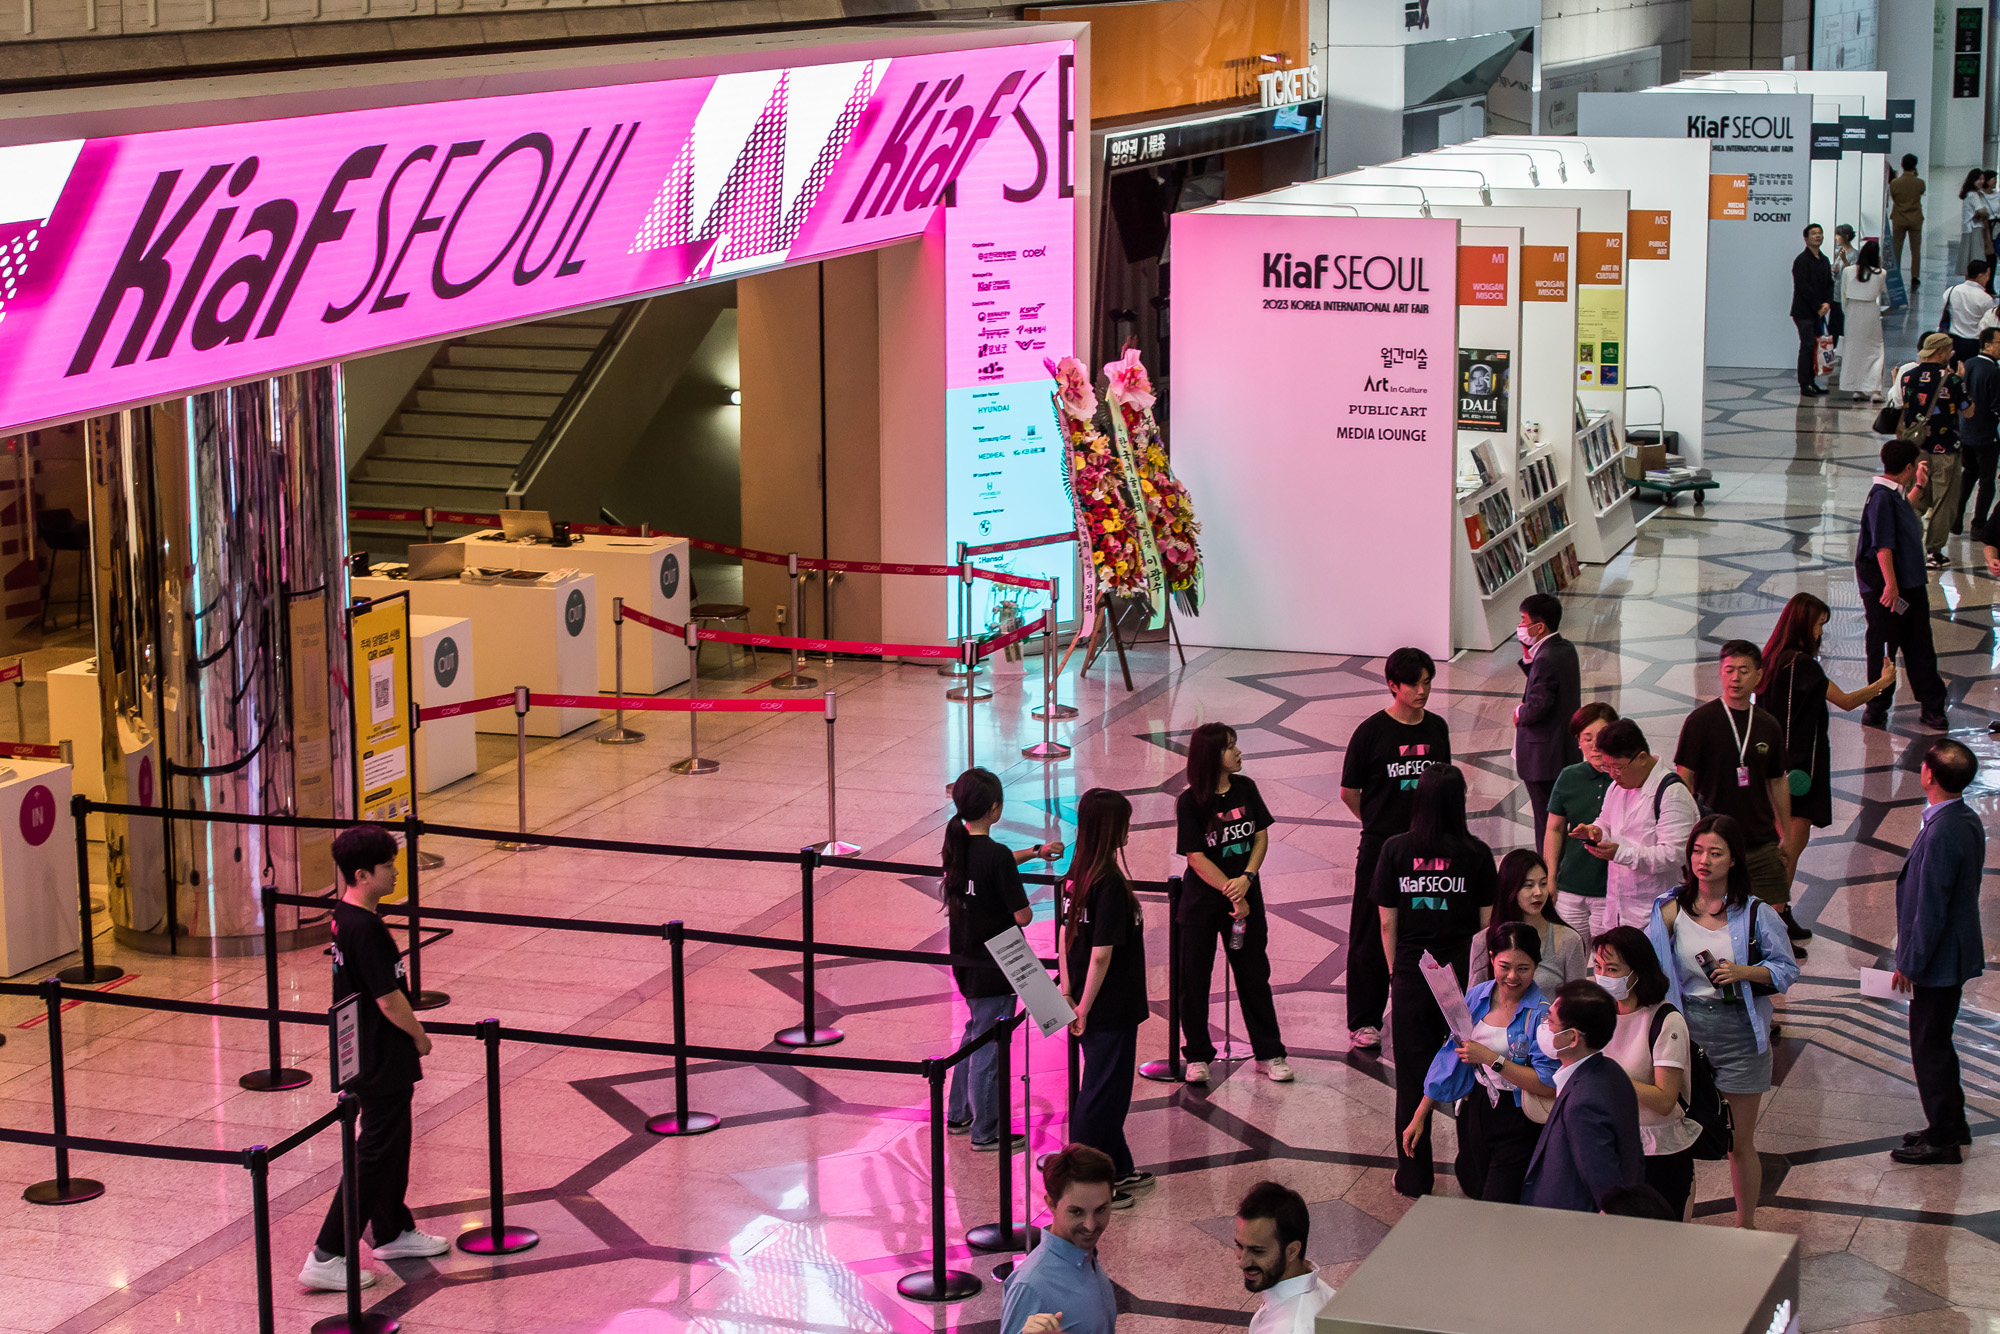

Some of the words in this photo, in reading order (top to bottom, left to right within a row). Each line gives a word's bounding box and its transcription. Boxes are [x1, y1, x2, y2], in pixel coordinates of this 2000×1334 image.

[1257, 65, 1319, 107] TICKETS
[1687, 116, 1730, 139] Kiaf
[1733, 116, 1794, 139] SEOUL
[842, 69, 1026, 224] Kiaf
[1112, 138, 1139, 167] 입장권
[1733, 180, 1746, 188] M4
[1655, 216, 1669, 225] M3
[1754, 213, 1792, 222] DOCENT
[65, 144, 388, 378] Kiaf
[321, 121, 641, 324] SEOUL
[1606, 238, 1620, 248] M2
[1022, 246, 1047, 258] coex
[1492, 253, 1505, 264] M1
[1553, 253, 1566, 263] M1
[1263, 253, 1329, 289] Kiaf
[1333, 255, 1430, 292] SEOUL
[1595, 272, 1620, 280] CULTURE
[1473, 283, 1505, 291] WOLGAN
[1535, 280, 1565, 288] WOLGAN
[1476, 292, 1504, 300] MISOOL
[1263, 299, 1289, 310] 2023
[1291, 300, 1322, 311] KOREA
[1324, 301, 1391, 313] INTERNATIONAL
[1393, 303, 1409, 314] ART
[1411, 304, 1430, 315] FAIR
[1380, 347, 1429, 370] 월간미술
[1364, 375, 1390, 393] Art
[978, 404, 1010, 414] HYUNDAI
[1349, 405, 1399, 416] PUBLIC
[1400, 407, 1428, 417] ART
[1460, 397, 1499, 412] DALÍ
[1337, 427, 1376, 441] MEDIA
[1378, 428, 1427, 442] LOUNGE
[829, 562, 848, 570] coex
[982, 554, 1004, 564] Hansol
[663, 567, 679, 586] OUT
[1147, 556, 1164, 595] 이광수
[568, 605, 583, 624] OUT
[698, 631, 717, 640] coex
[752, 637, 771, 645] coex
[809, 642, 828, 650] coex
[368, 650, 378, 661] QR
[379, 647, 394, 659] code
[438, 653, 455, 674] OUT
[441, 705, 462, 716] coex
[554, 697, 580, 706] coex
[622, 699, 647, 709] coex
[690, 701, 716, 710] coex
[760, 701, 785, 711] coex
[14, 745, 35, 755] coex
[1387, 761, 1412, 778] Kiaf
[32, 805, 44, 828] IN
[1399, 876, 1426, 893] Kiaf
[1426, 876, 1467, 893] SEOUL
